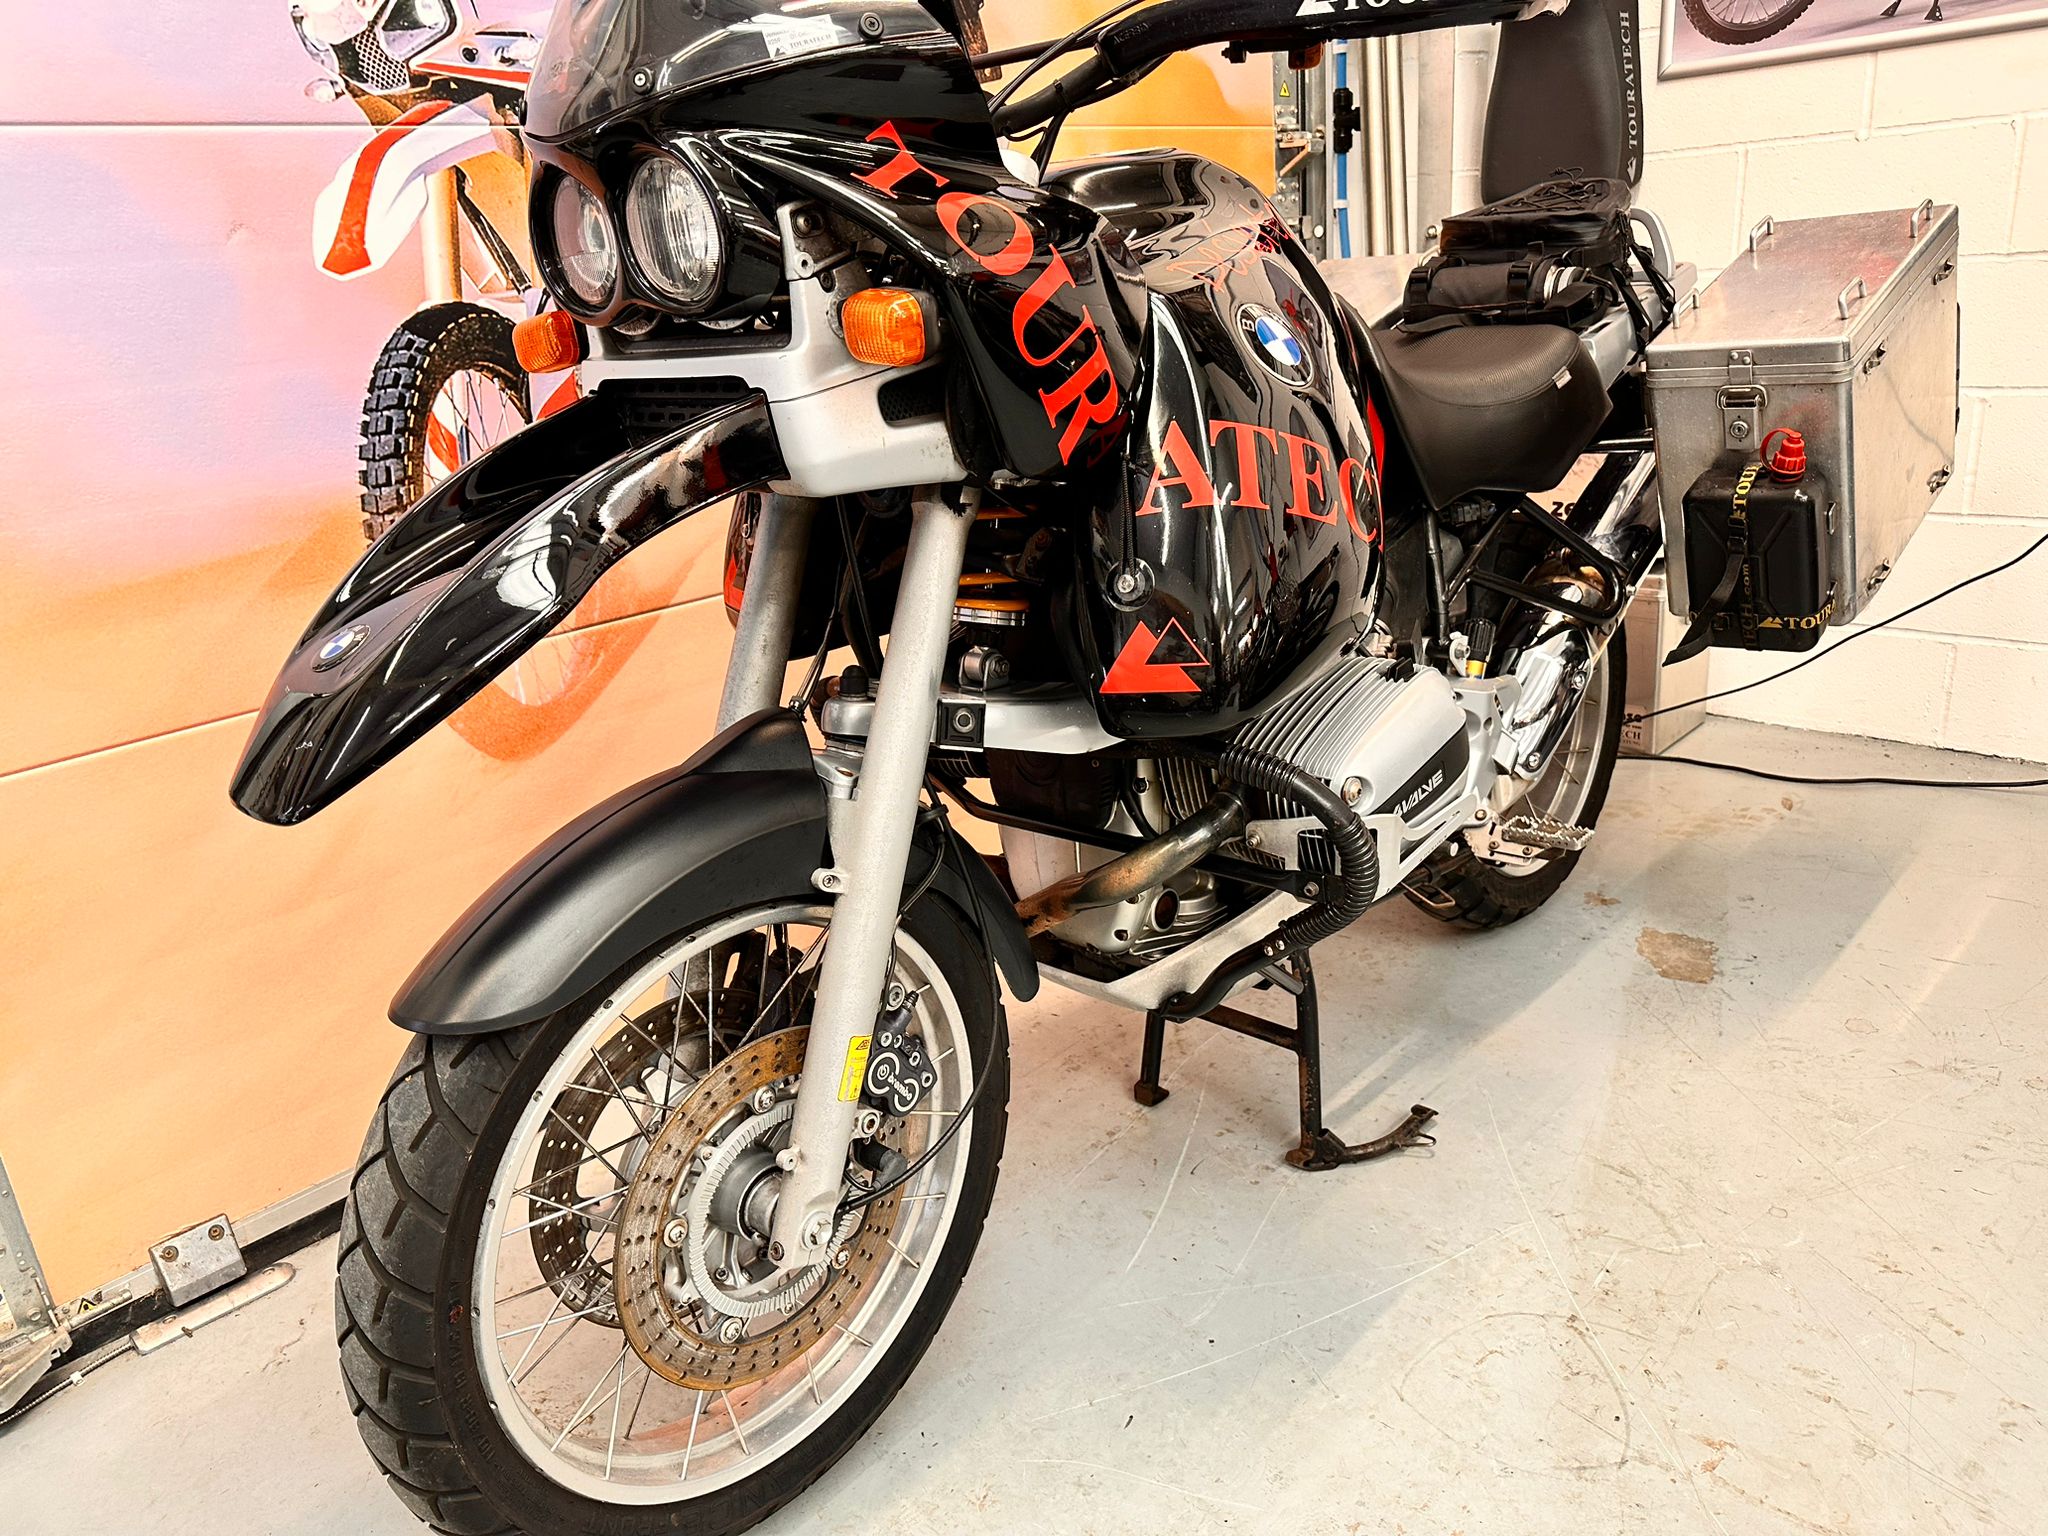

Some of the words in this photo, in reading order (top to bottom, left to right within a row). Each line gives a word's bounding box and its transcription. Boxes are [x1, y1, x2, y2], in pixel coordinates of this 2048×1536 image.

[1619, 11, 1638, 149] TOURATECH
[1135, 419, 1384, 553] ATEC
[887, 1072, 913, 1101] brembo
